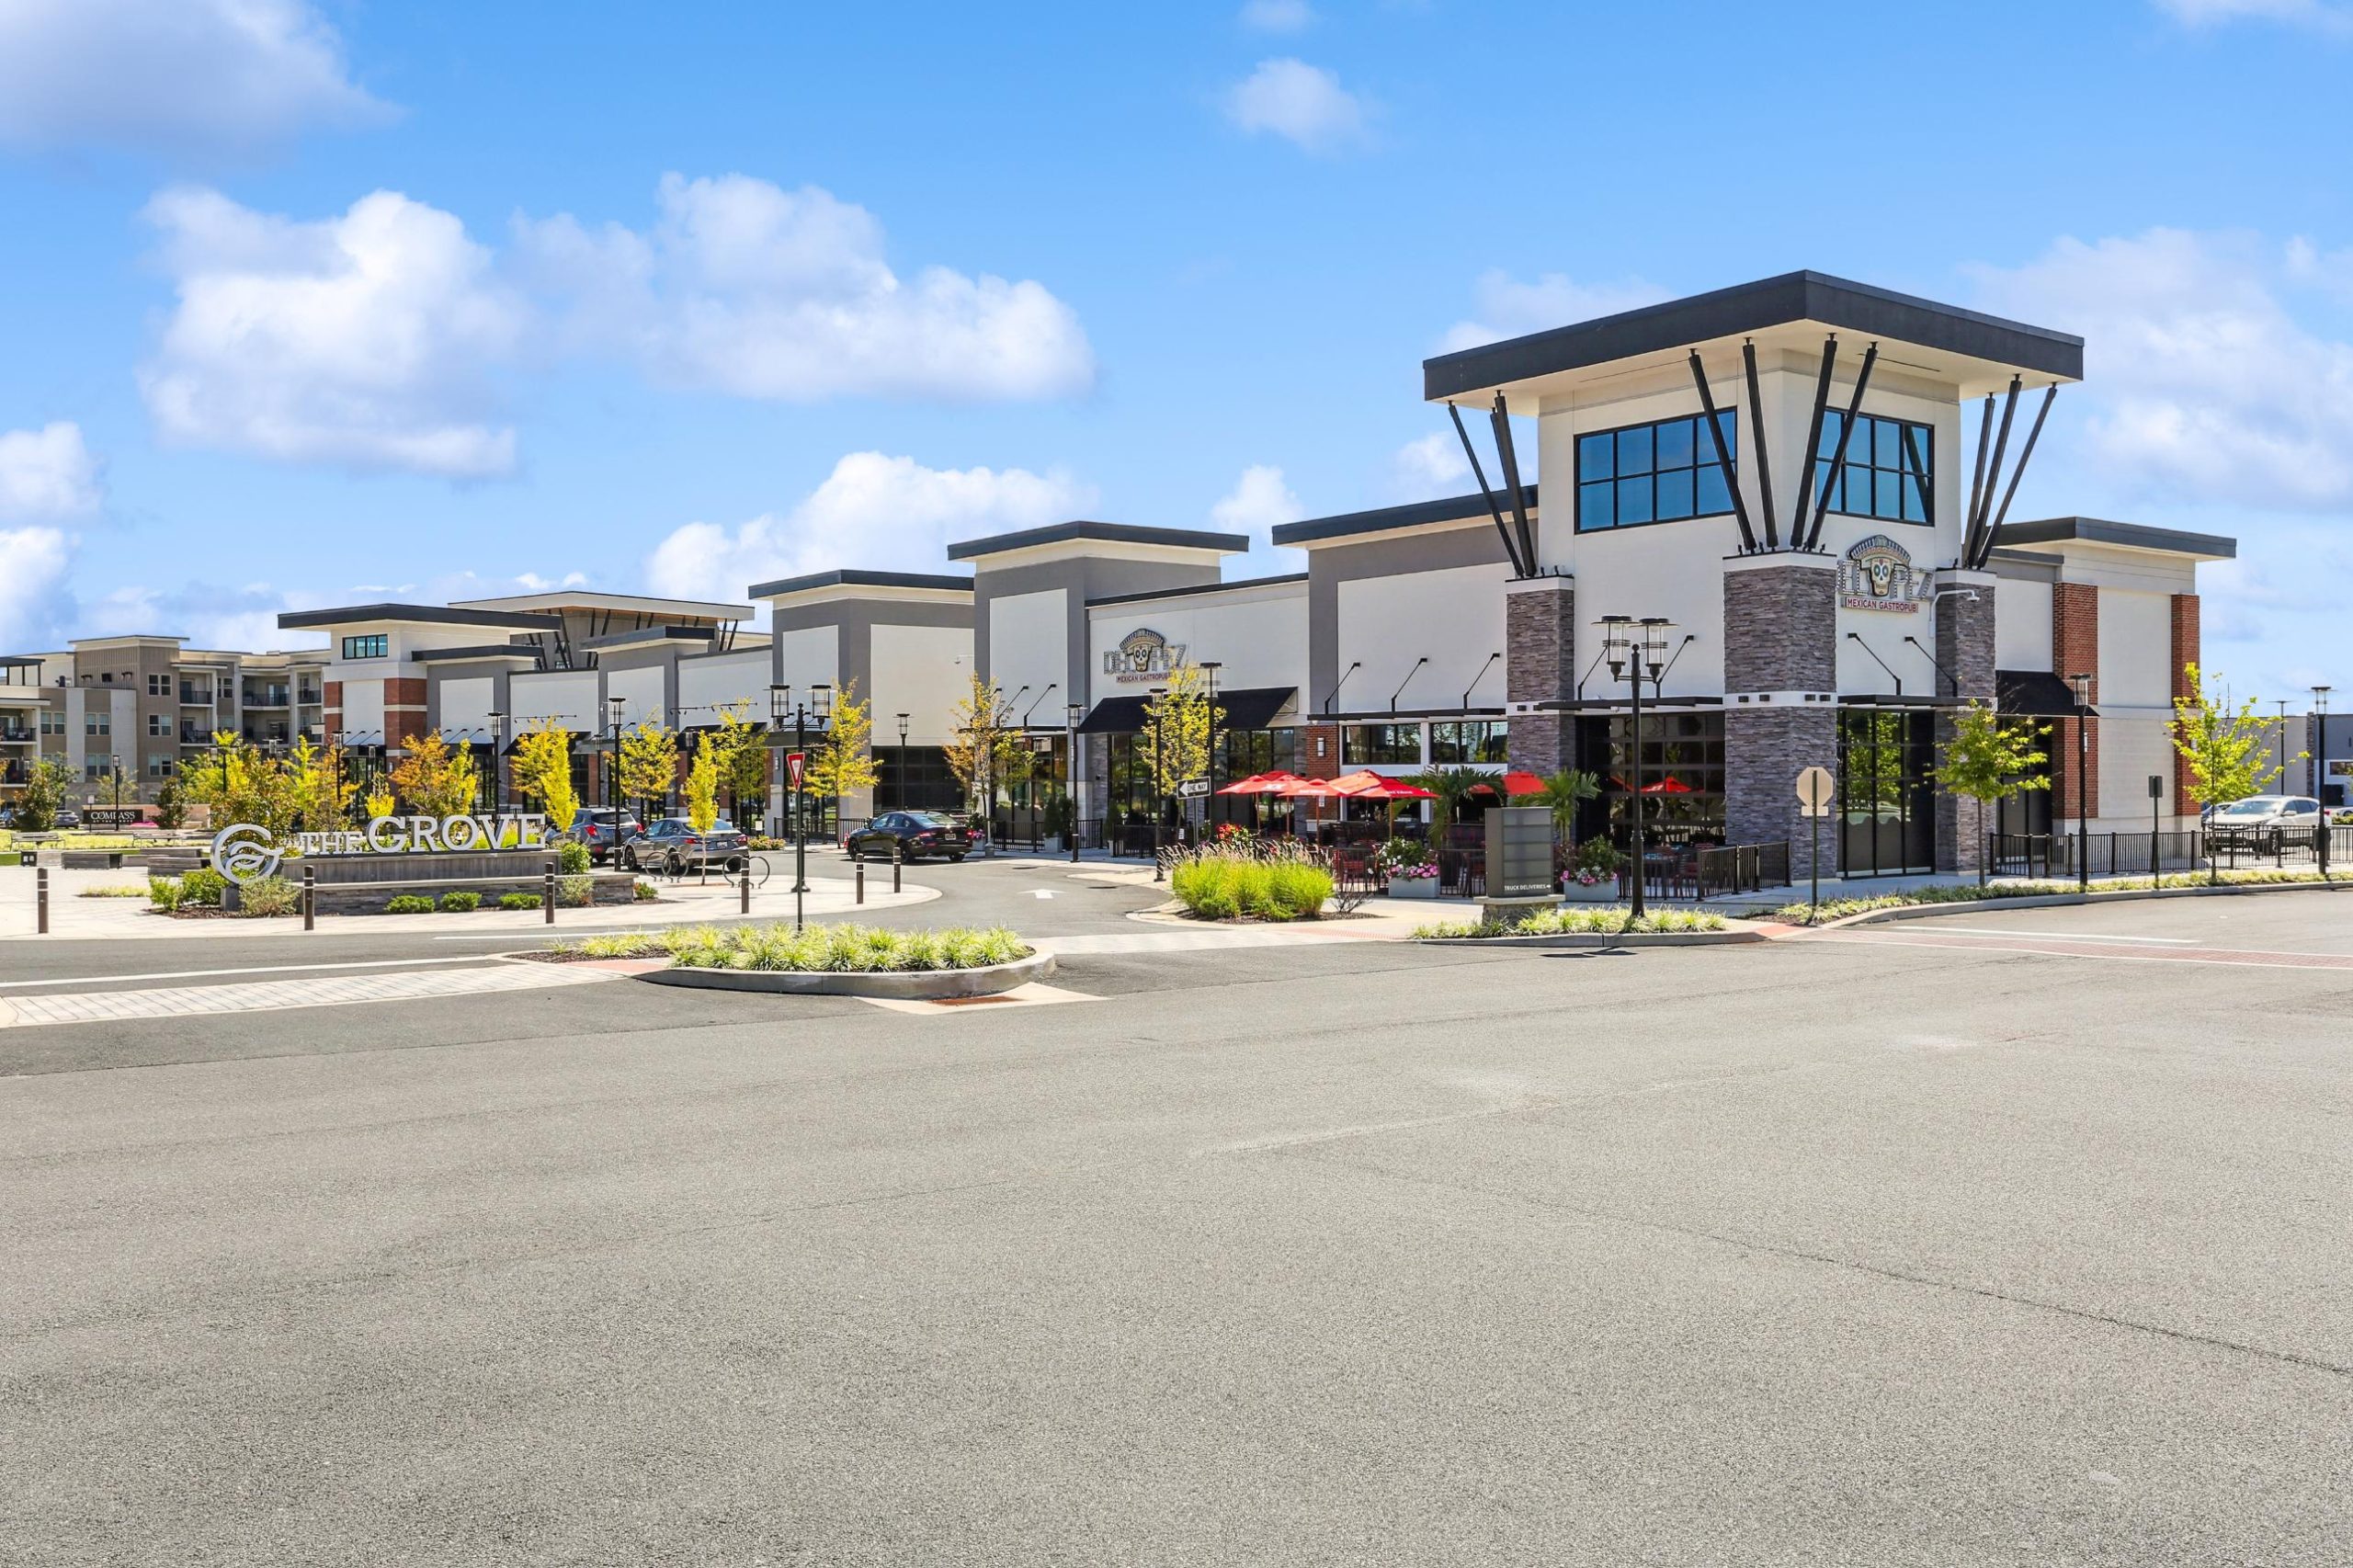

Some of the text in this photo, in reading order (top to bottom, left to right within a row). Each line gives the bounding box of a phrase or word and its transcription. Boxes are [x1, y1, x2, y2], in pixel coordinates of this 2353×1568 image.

[1847, 598, 1916, 612] MEXICAN GASTROPUB
[1117, 675, 1138, 683] MEXICAN
[298, 813, 546, 856] THE GROVE
